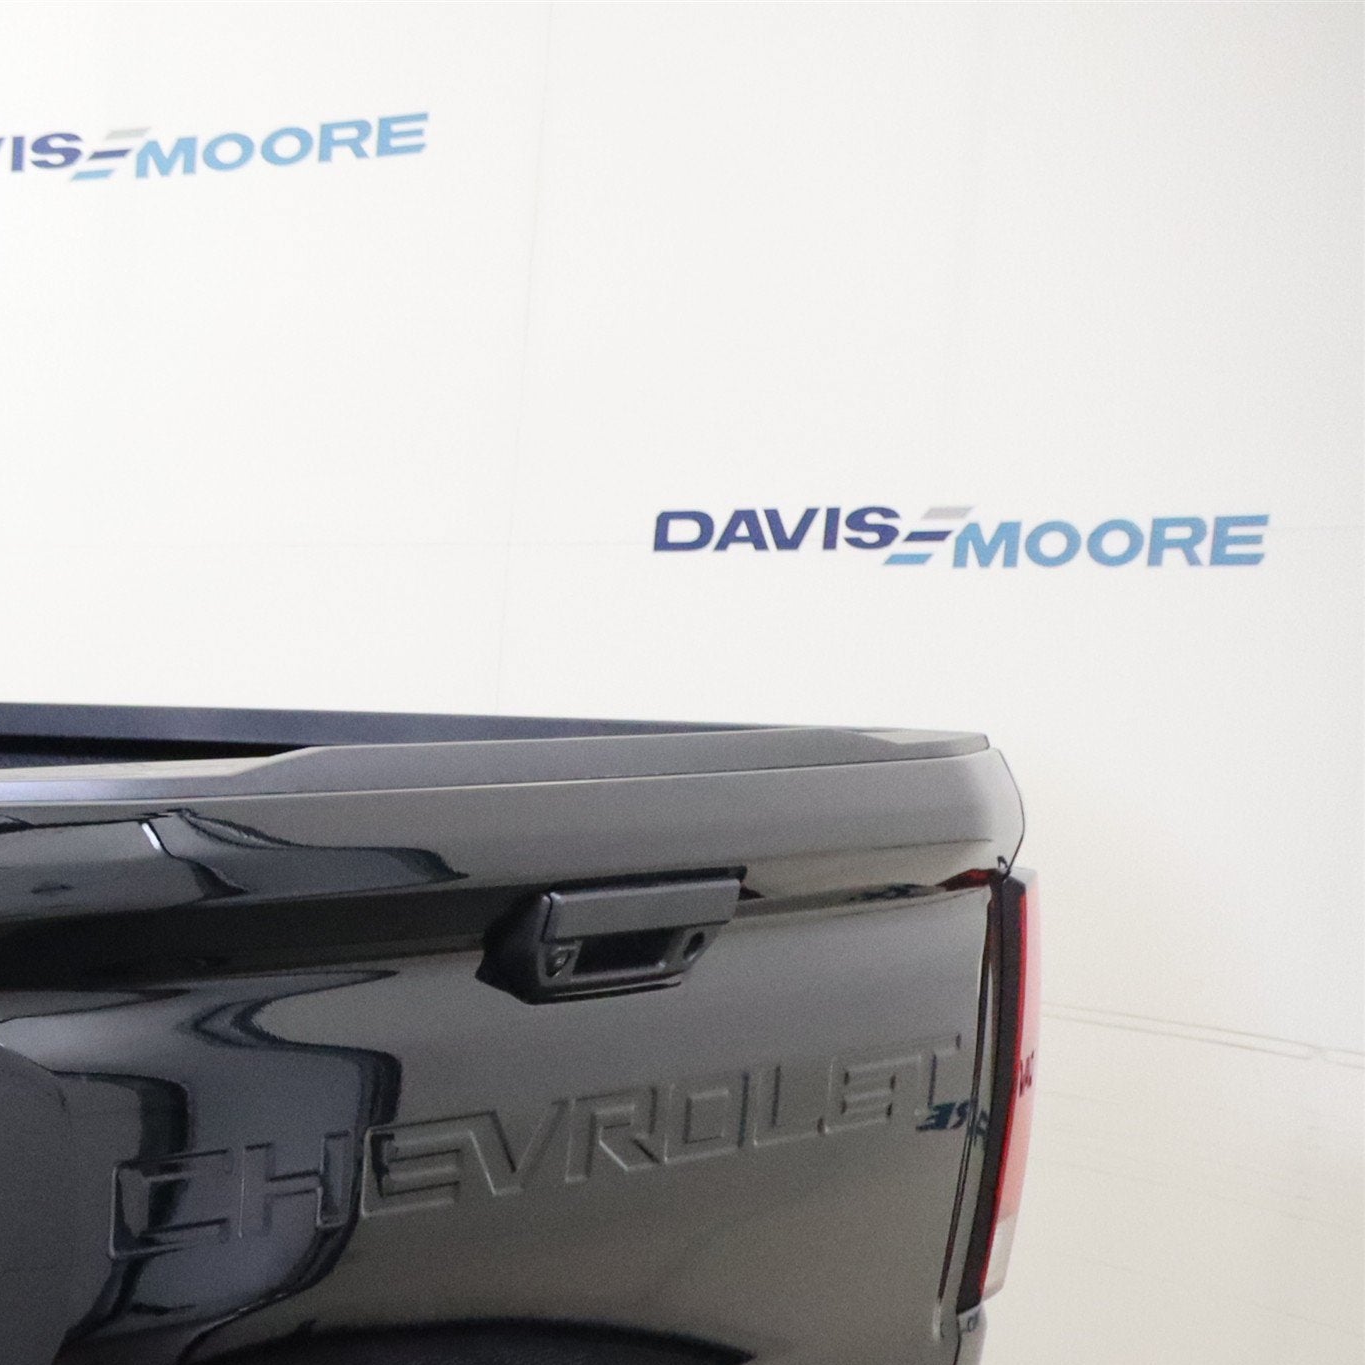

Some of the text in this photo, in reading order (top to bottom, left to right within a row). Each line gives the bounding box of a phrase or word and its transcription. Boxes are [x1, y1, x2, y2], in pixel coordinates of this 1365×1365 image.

[135, 112, 429, 180] MOORE
[653, 506, 1269, 569] DAVIS MOORE
[109, 1032, 961, 1258] CHEVROLET
